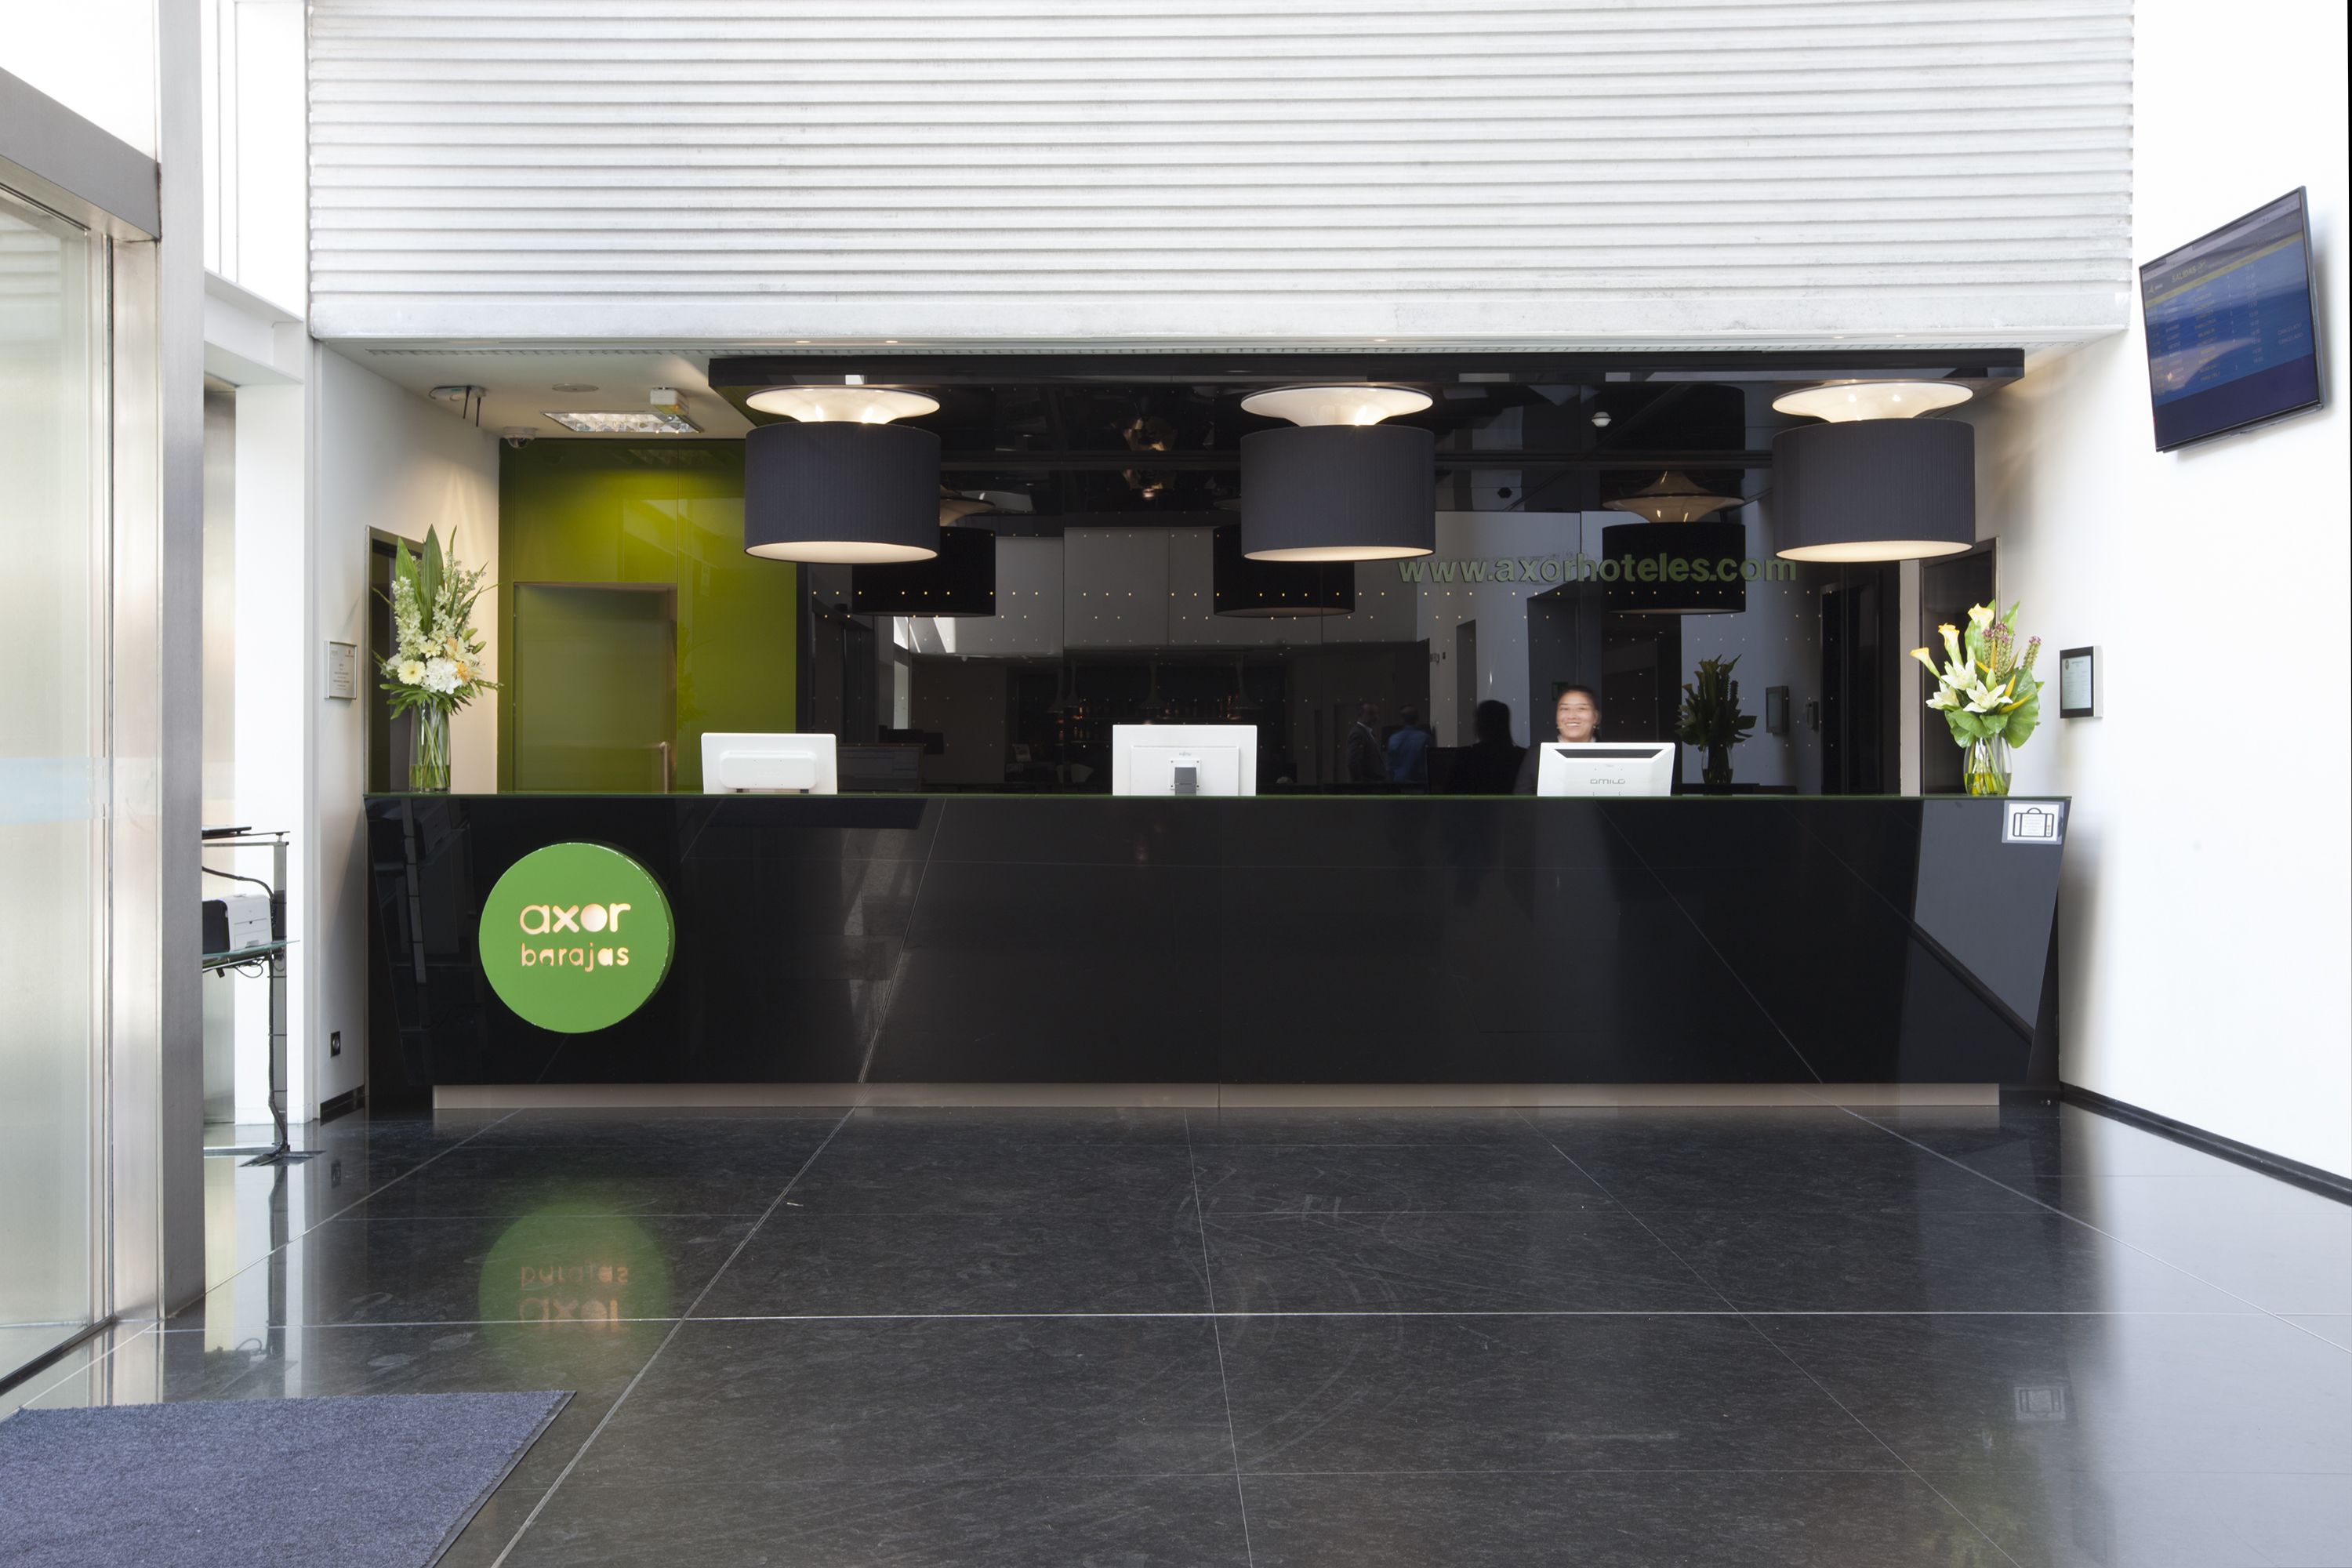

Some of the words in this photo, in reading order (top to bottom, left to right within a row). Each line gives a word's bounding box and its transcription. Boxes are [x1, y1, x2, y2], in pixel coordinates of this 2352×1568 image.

[1398, 553, 1797, 583] www.axorhoteles.com
[519, 902, 632, 935] axor
[521, 942, 630, 973] barajas
